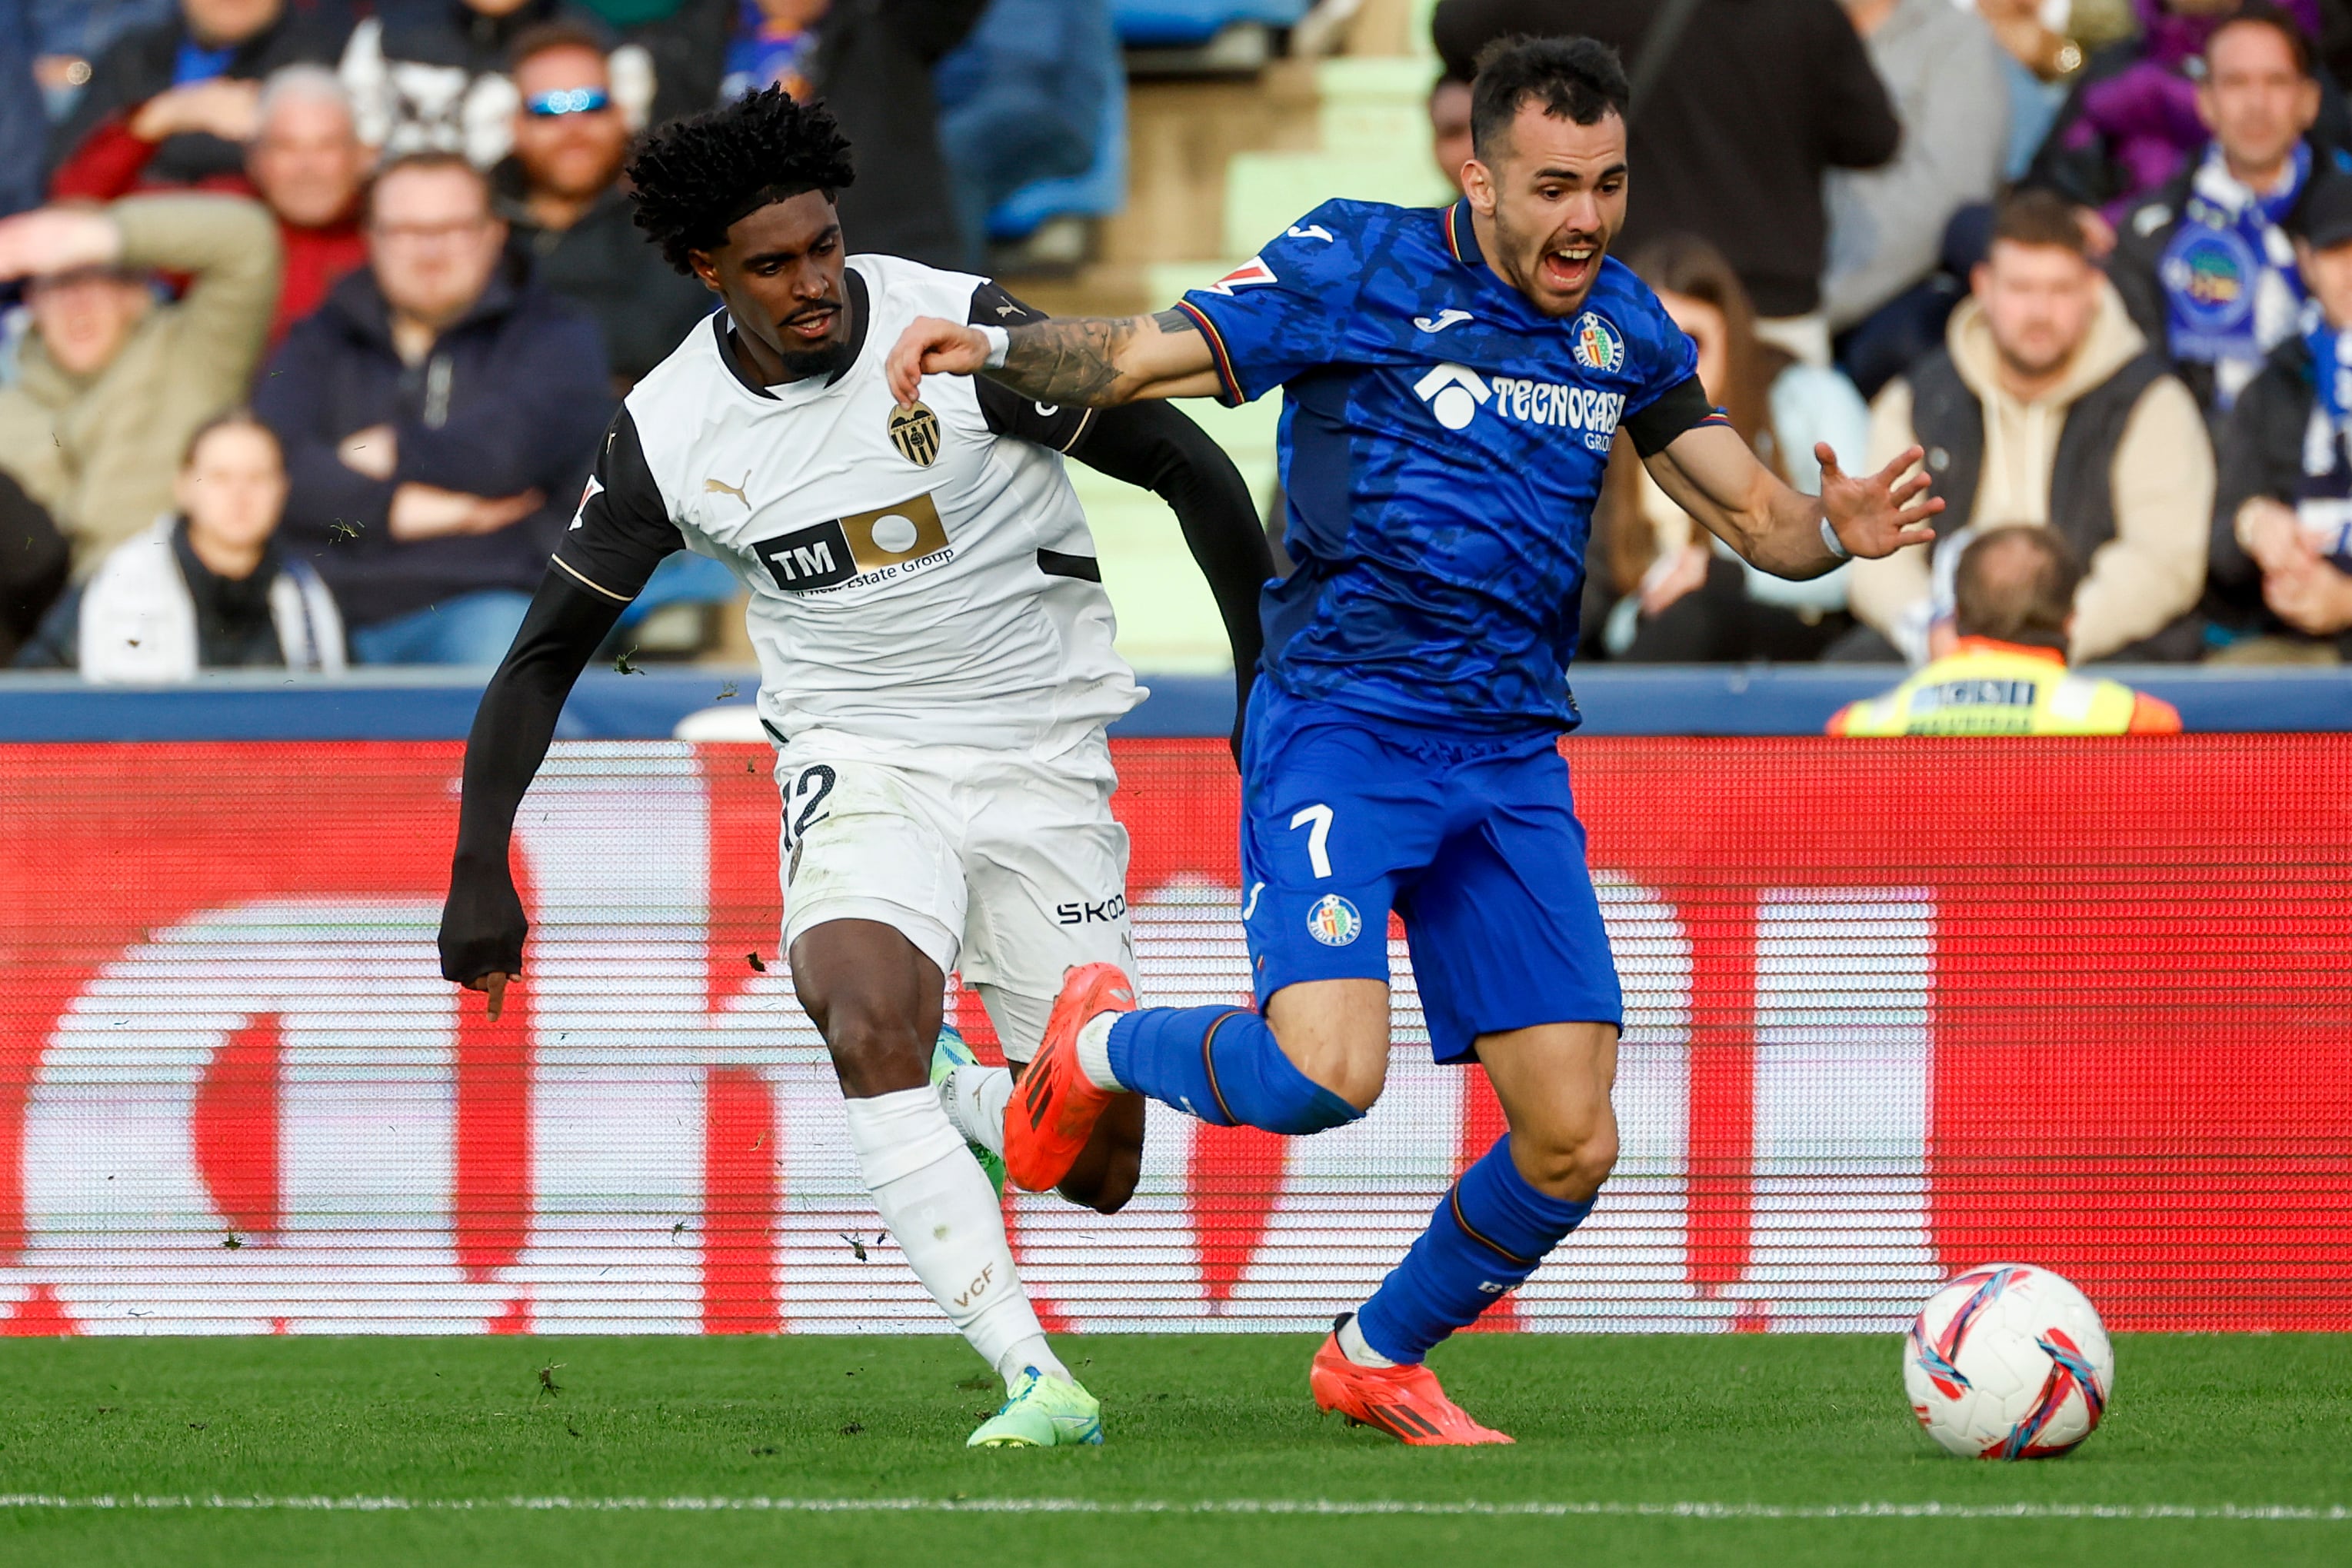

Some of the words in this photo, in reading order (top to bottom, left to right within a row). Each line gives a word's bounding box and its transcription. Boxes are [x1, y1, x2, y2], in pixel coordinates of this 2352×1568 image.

[1585, 432, 1614, 453] GRO
[769, 541, 837, 581] TM
[848, 567, 897, 589] Estate
[902, 547, 954, 573] Group
[782, 764, 837, 853] 12
[1290, 804, 1334, 879] 7
[1057, 894, 1125, 925] SKOD
[954, 1262, 992, 1307] VCF
